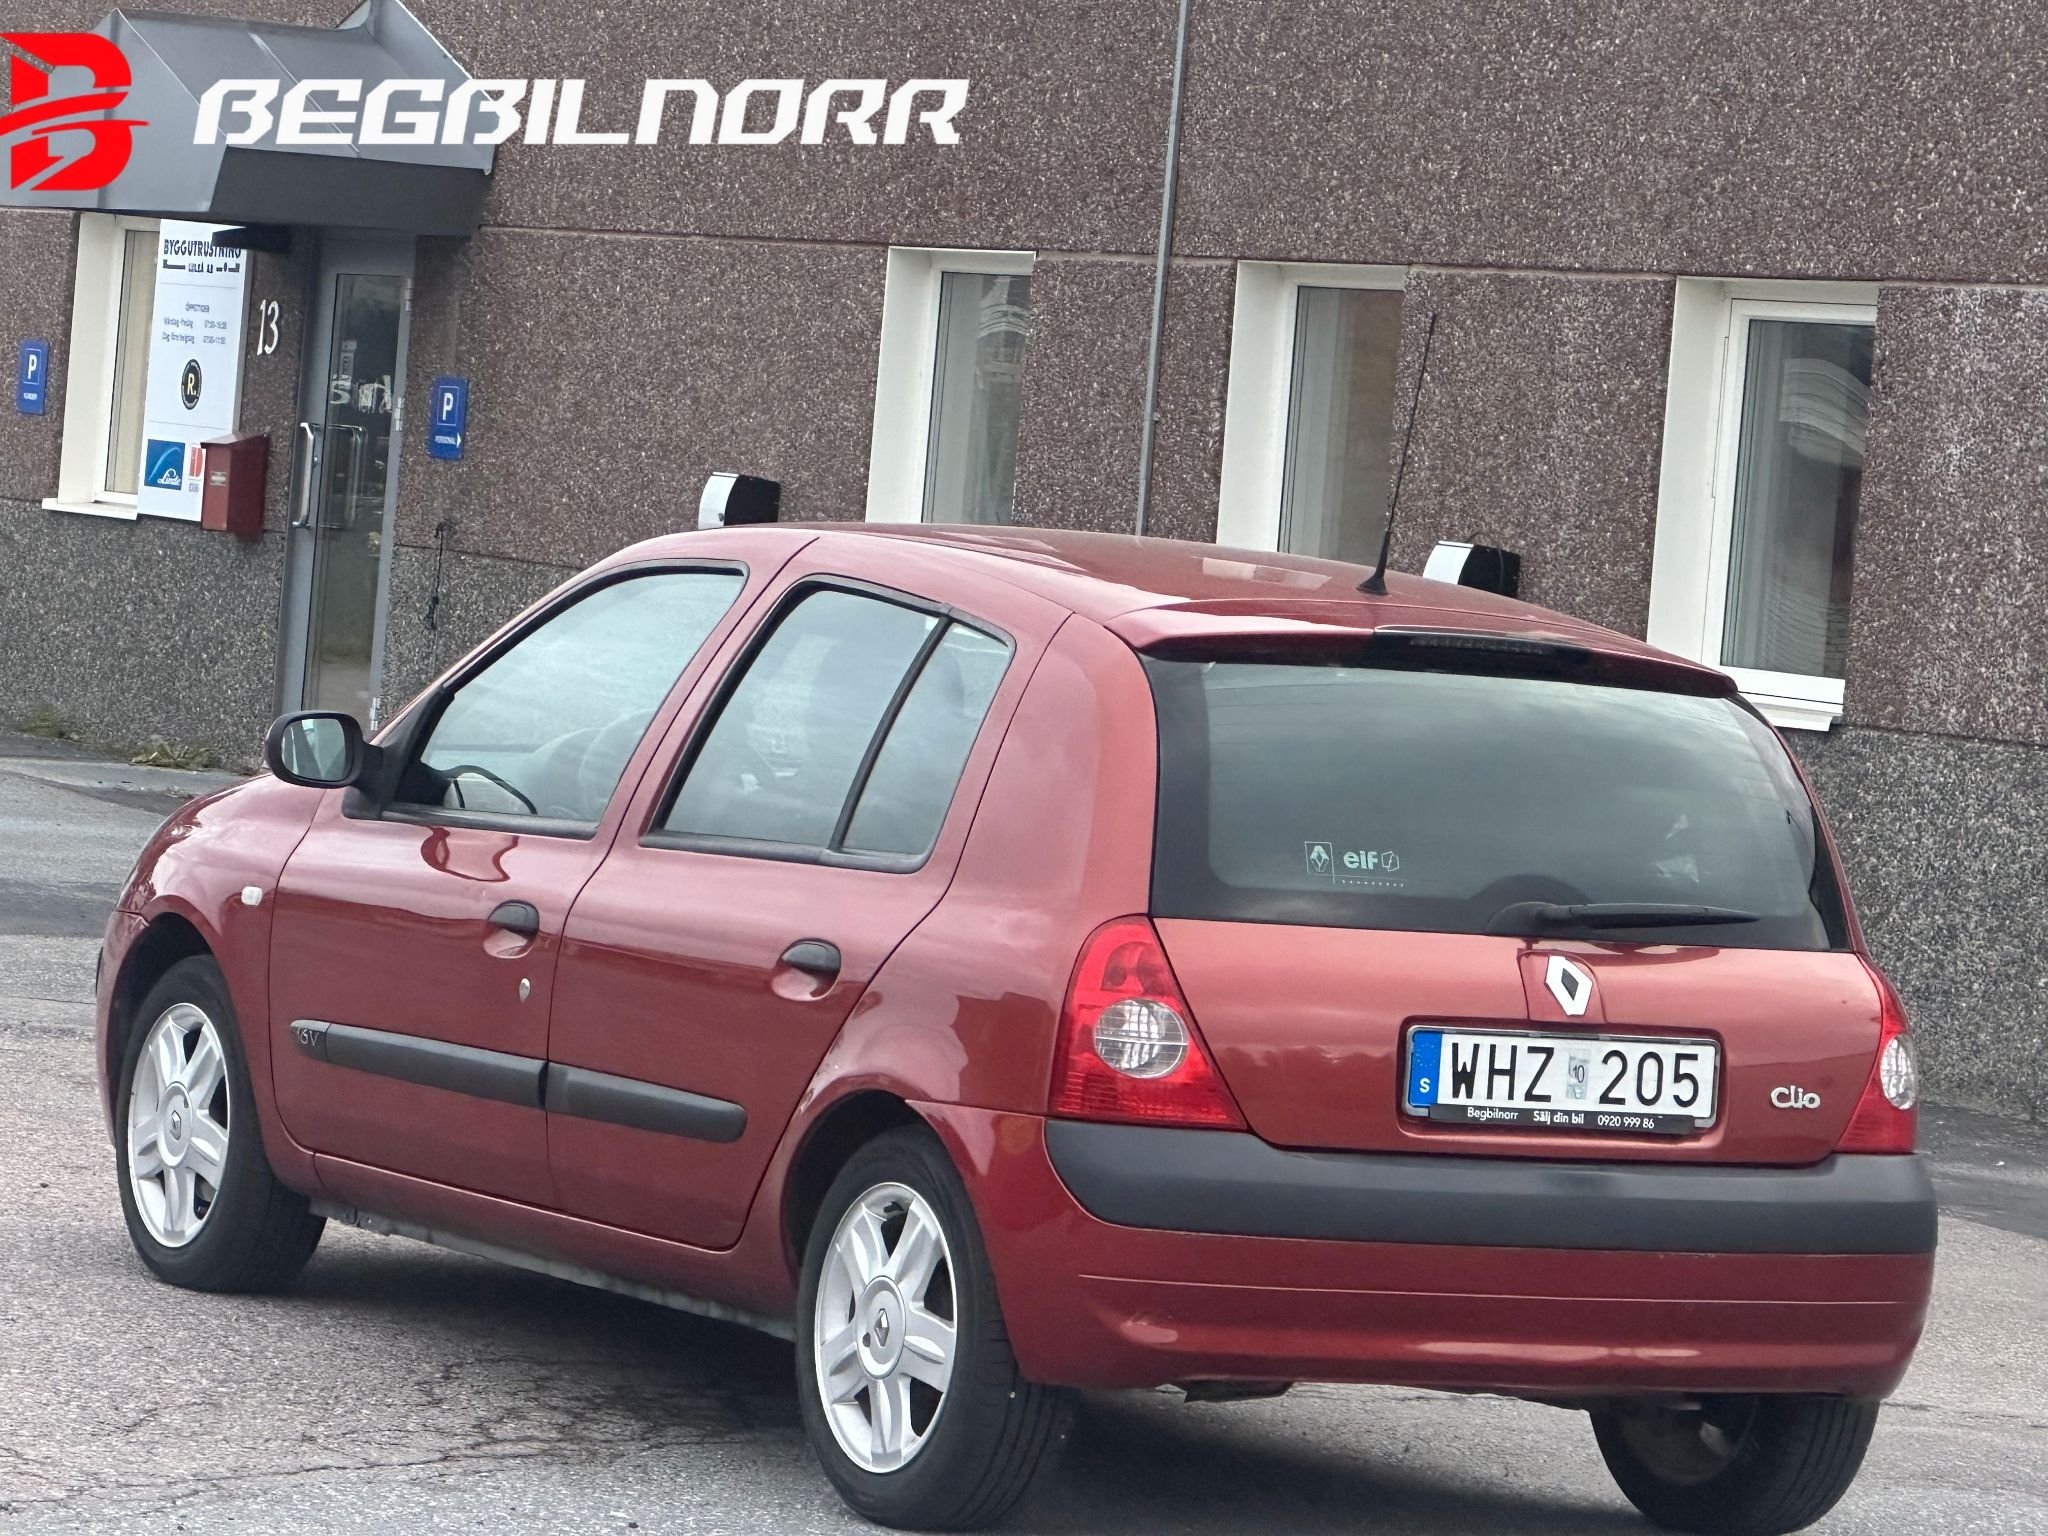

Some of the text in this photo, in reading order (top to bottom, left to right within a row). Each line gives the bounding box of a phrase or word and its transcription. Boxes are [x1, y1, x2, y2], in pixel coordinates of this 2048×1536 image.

[257, 299, 279, 356] 13
[28, 354, 37, 379] P
[442, 392, 453, 421] P
[1343, 851, 1378, 869] elf
[1419, 1077, 1431, 1093] S
[1452, 1042, 1699, 1108] WHZ 205
[1573, 1065, 1585, 1083] 10
[1770, 1085, 1821, 1110] Clio
[1467, 1106, 1655, 1129] Begbilnorr Sälj din bil 0920 999 86
